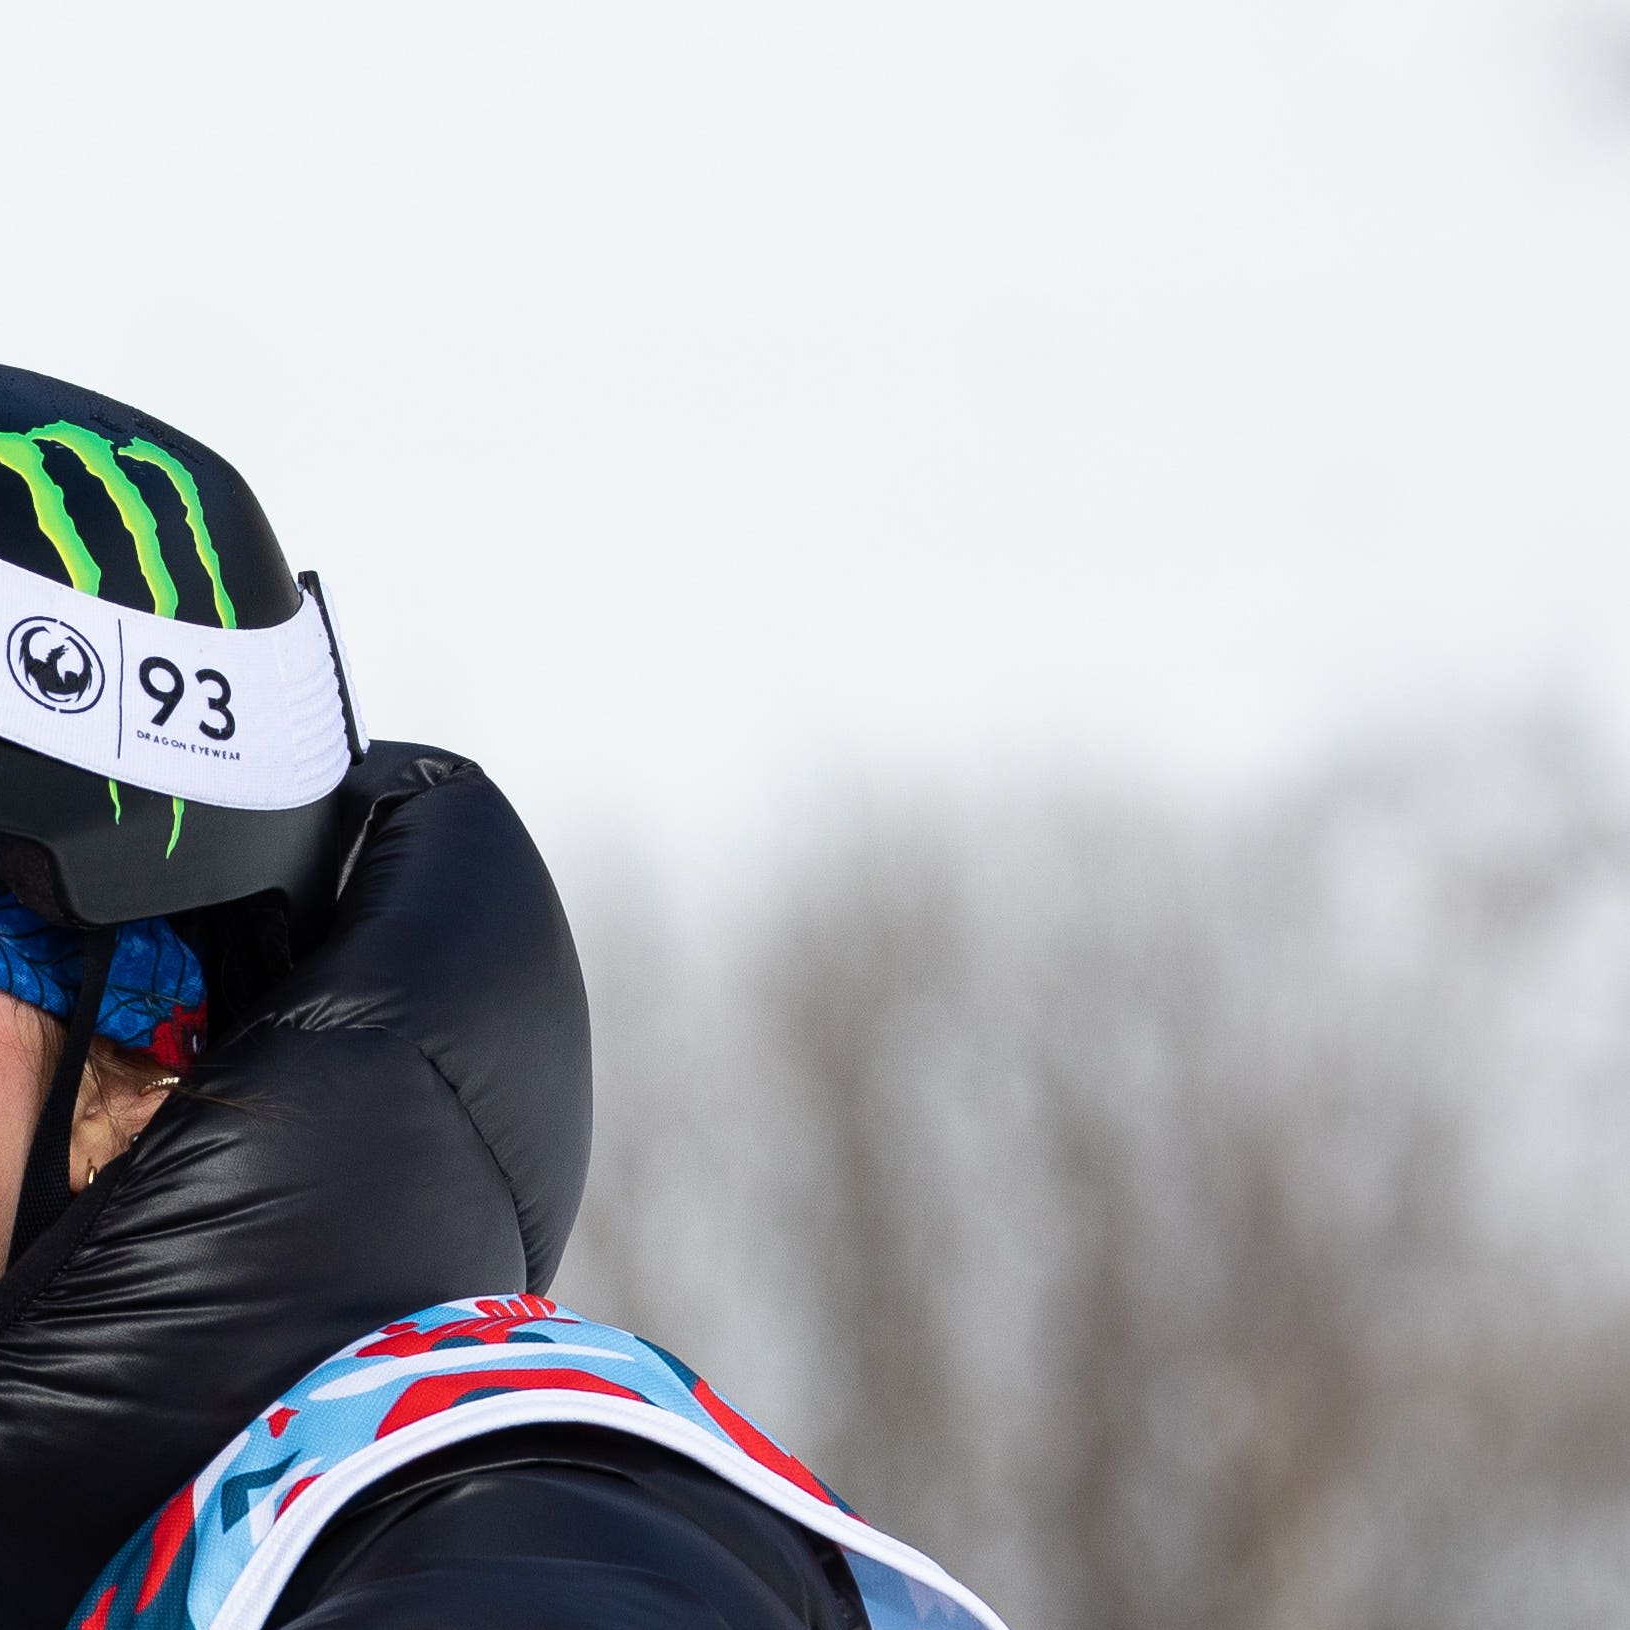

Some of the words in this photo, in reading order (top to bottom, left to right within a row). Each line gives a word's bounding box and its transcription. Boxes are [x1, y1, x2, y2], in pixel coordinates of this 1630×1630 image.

[138, 655, 236, 741] 93
[136, 730, 187, 750] DRAGON
[190, 744, 241, 760] EYEWEAR
